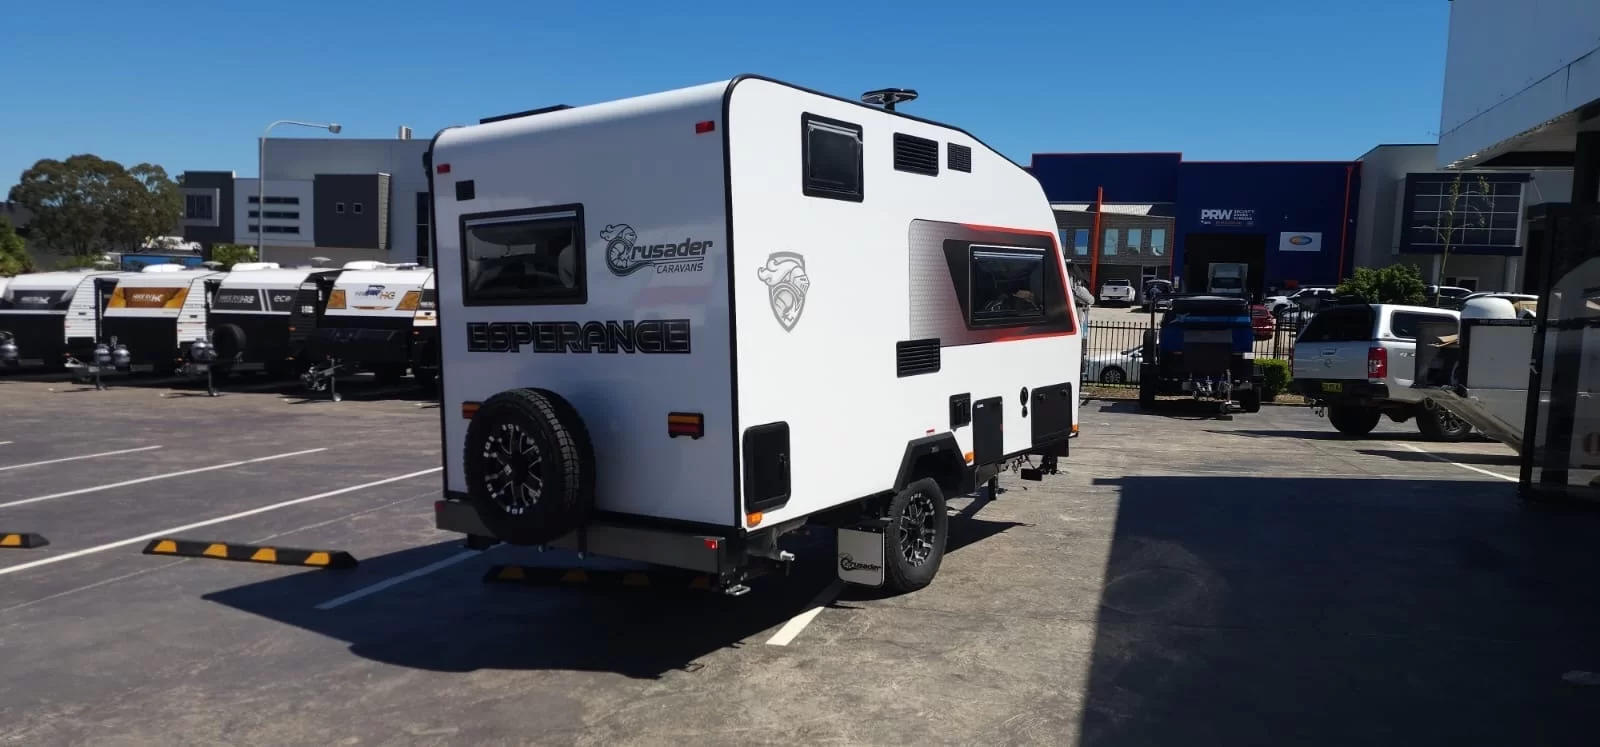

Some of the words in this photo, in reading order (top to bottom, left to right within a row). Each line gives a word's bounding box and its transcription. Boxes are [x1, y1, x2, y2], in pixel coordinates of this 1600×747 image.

[1201, 209, 1233, 220] PRW
[656, 263, 704, 274] CARAVANS
[467, 320, 691, 353] ESPERANCE
